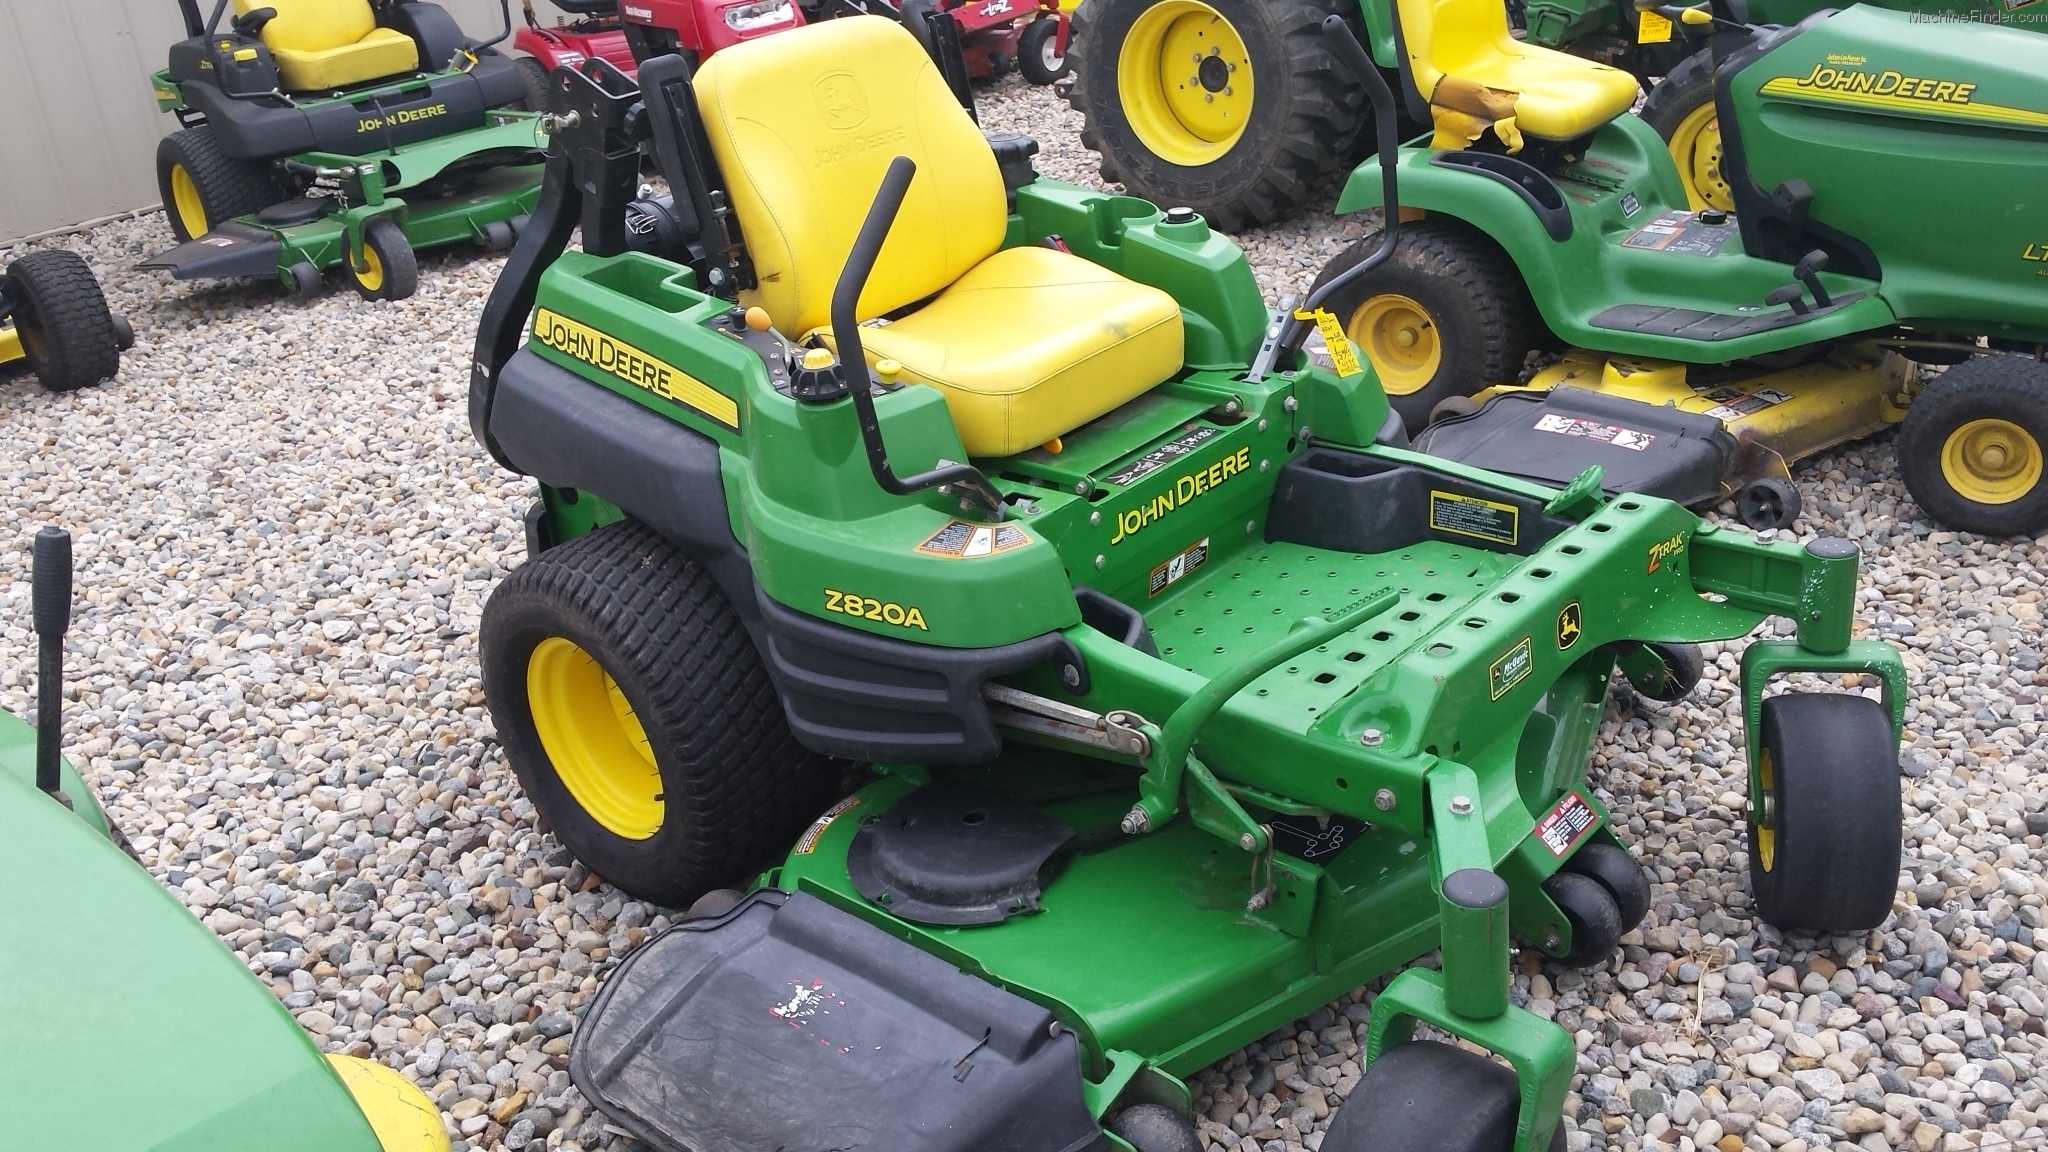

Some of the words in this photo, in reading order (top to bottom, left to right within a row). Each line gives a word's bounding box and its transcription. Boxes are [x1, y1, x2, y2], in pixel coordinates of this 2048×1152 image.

[1798, 63, 1876, 93] JOHN
[1873, 71, 1976, 104] DEERE
[398, 104, 447, 125] DEERE
[815, 142, 855, 170] JOHN
[852, 127, 906, 154] DEERE
[543, 315, 594, 361] JOHN
[600, 337, 672, 396] DEERE
[1111, 489, 1175, 545] JOHN
[1176, 447, 1250, 506] DEERE
[824, 588, 929, 631] Z820A
